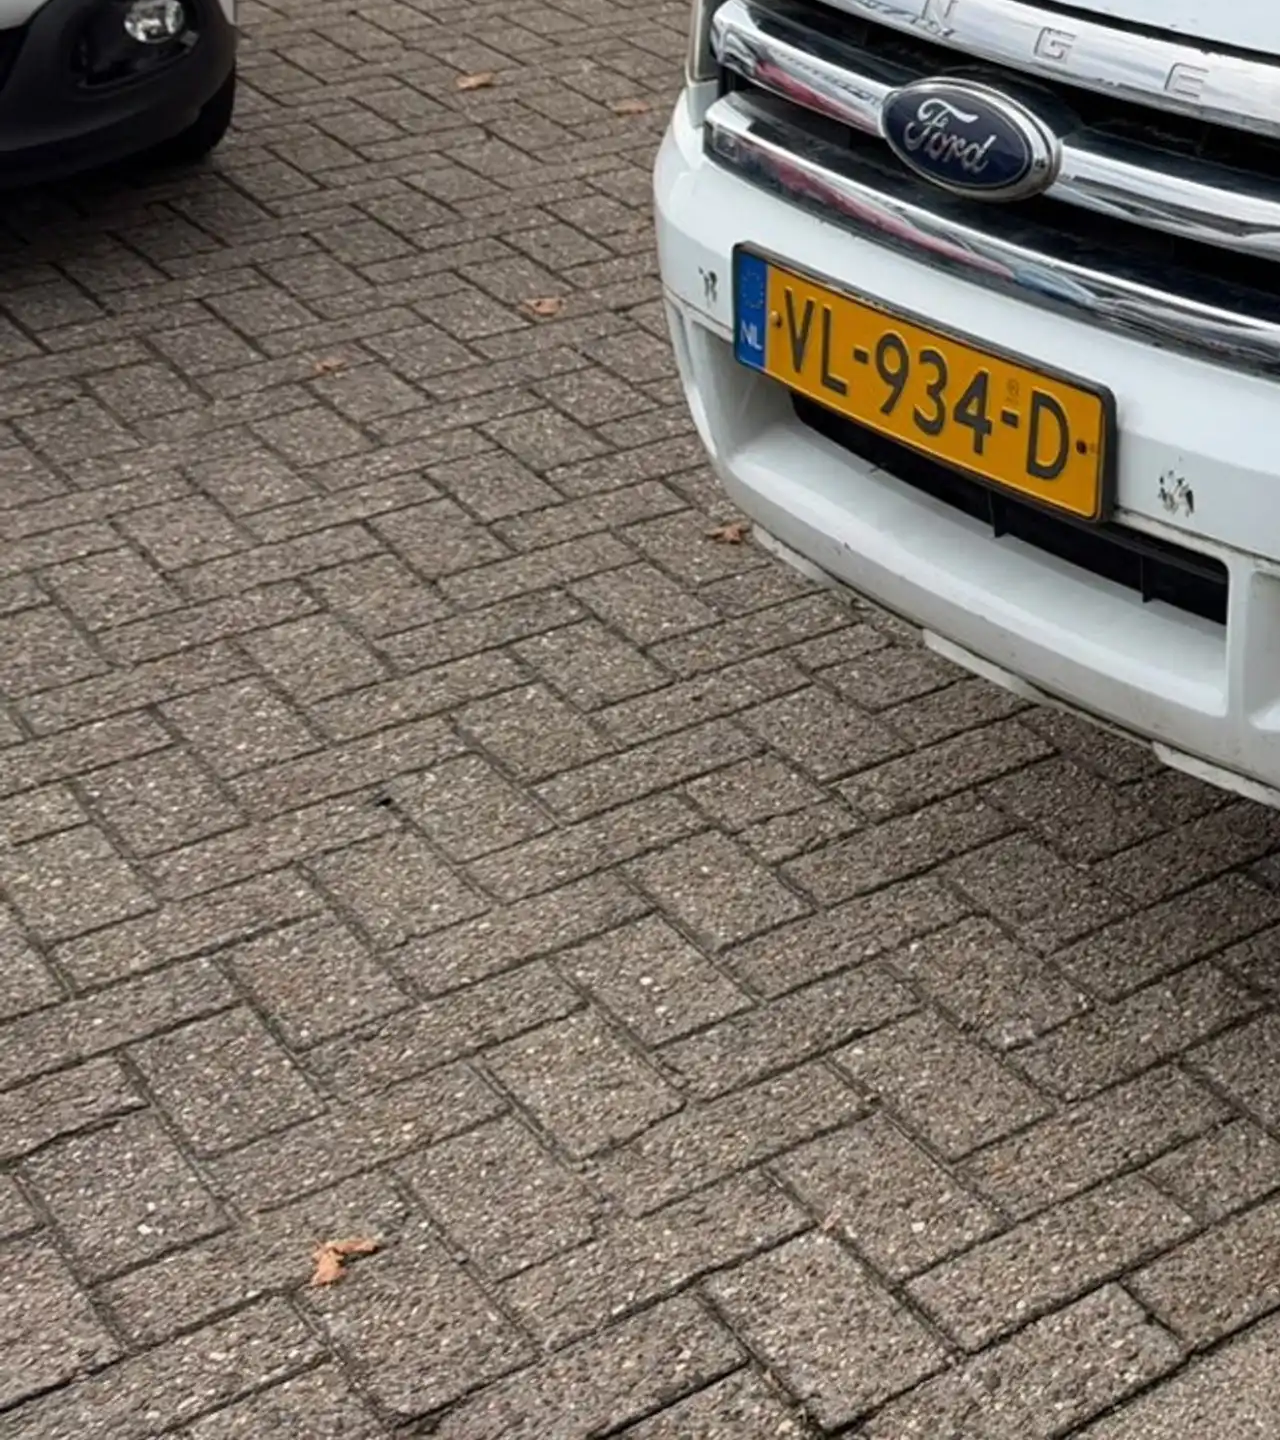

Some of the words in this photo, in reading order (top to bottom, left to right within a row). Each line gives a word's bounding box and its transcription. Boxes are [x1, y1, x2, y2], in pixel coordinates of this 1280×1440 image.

[904, 97, 994, 177] Ford
[740, 319, 763, 351] NL
[784, 286, 1069, 480] VL-934-D
